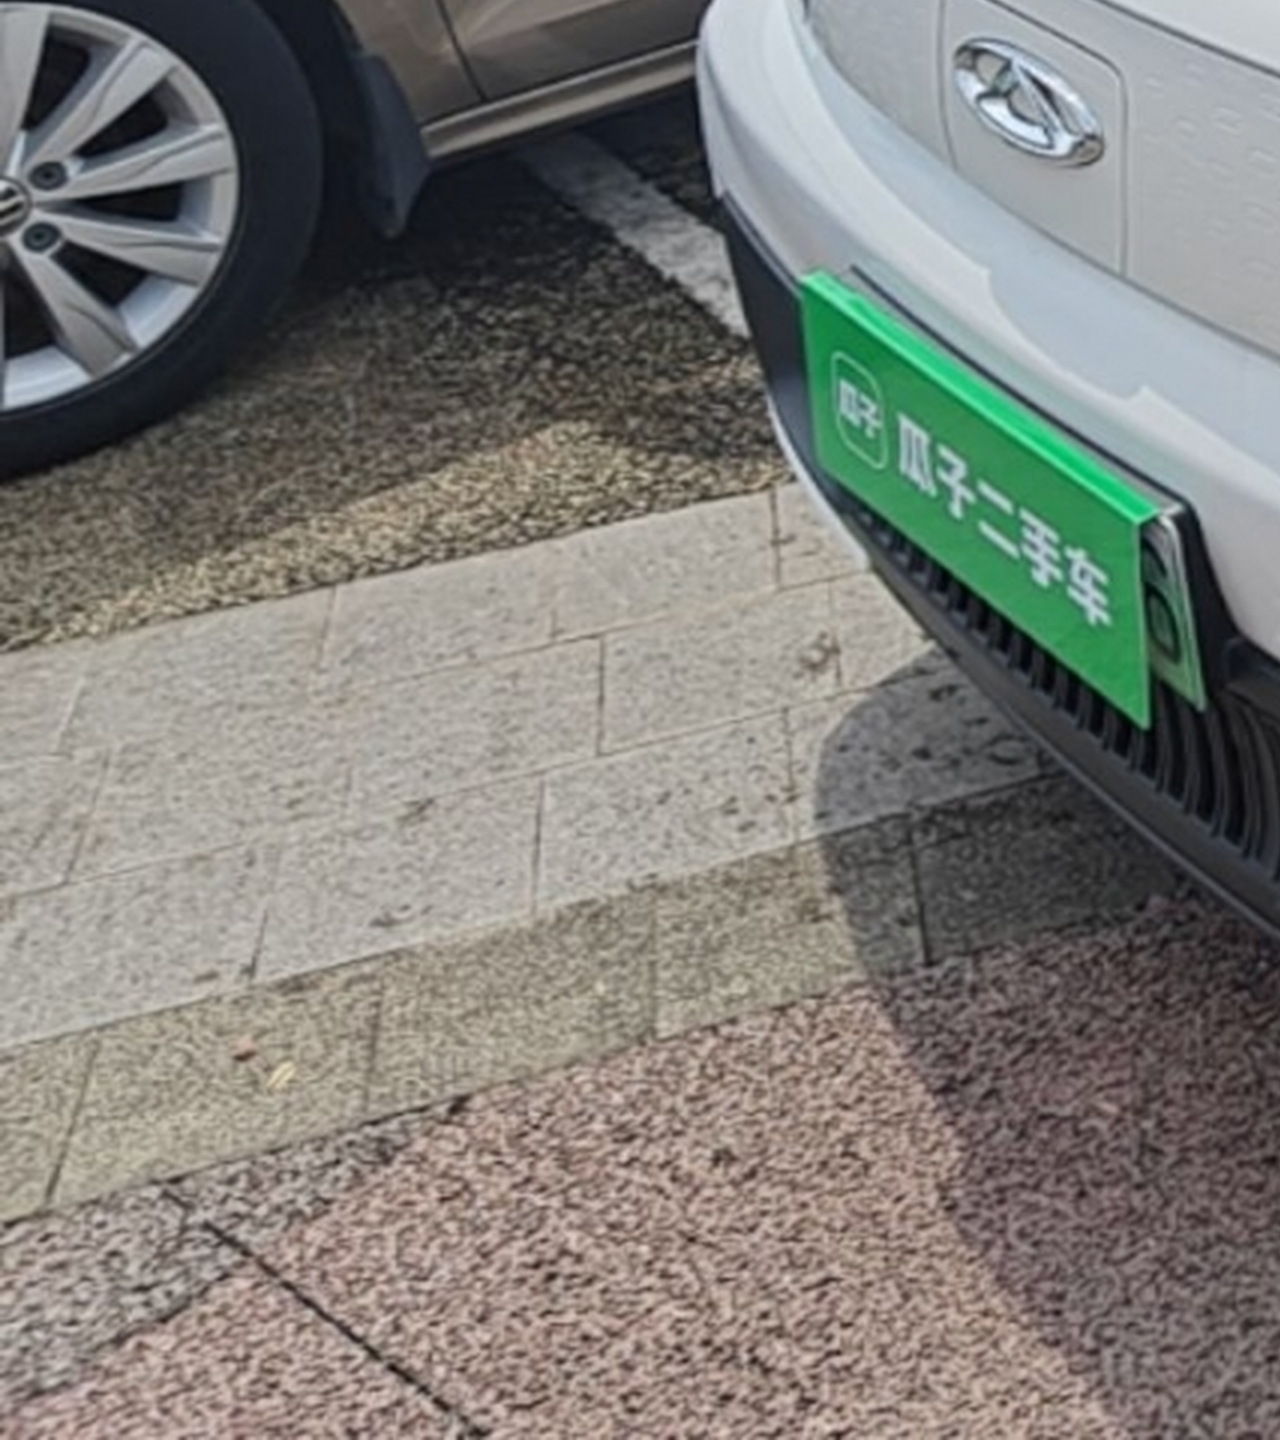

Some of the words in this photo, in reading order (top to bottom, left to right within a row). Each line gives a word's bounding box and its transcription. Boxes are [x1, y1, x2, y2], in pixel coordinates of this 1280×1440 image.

[898, 412, 1112, 627] 瓜子二手车
